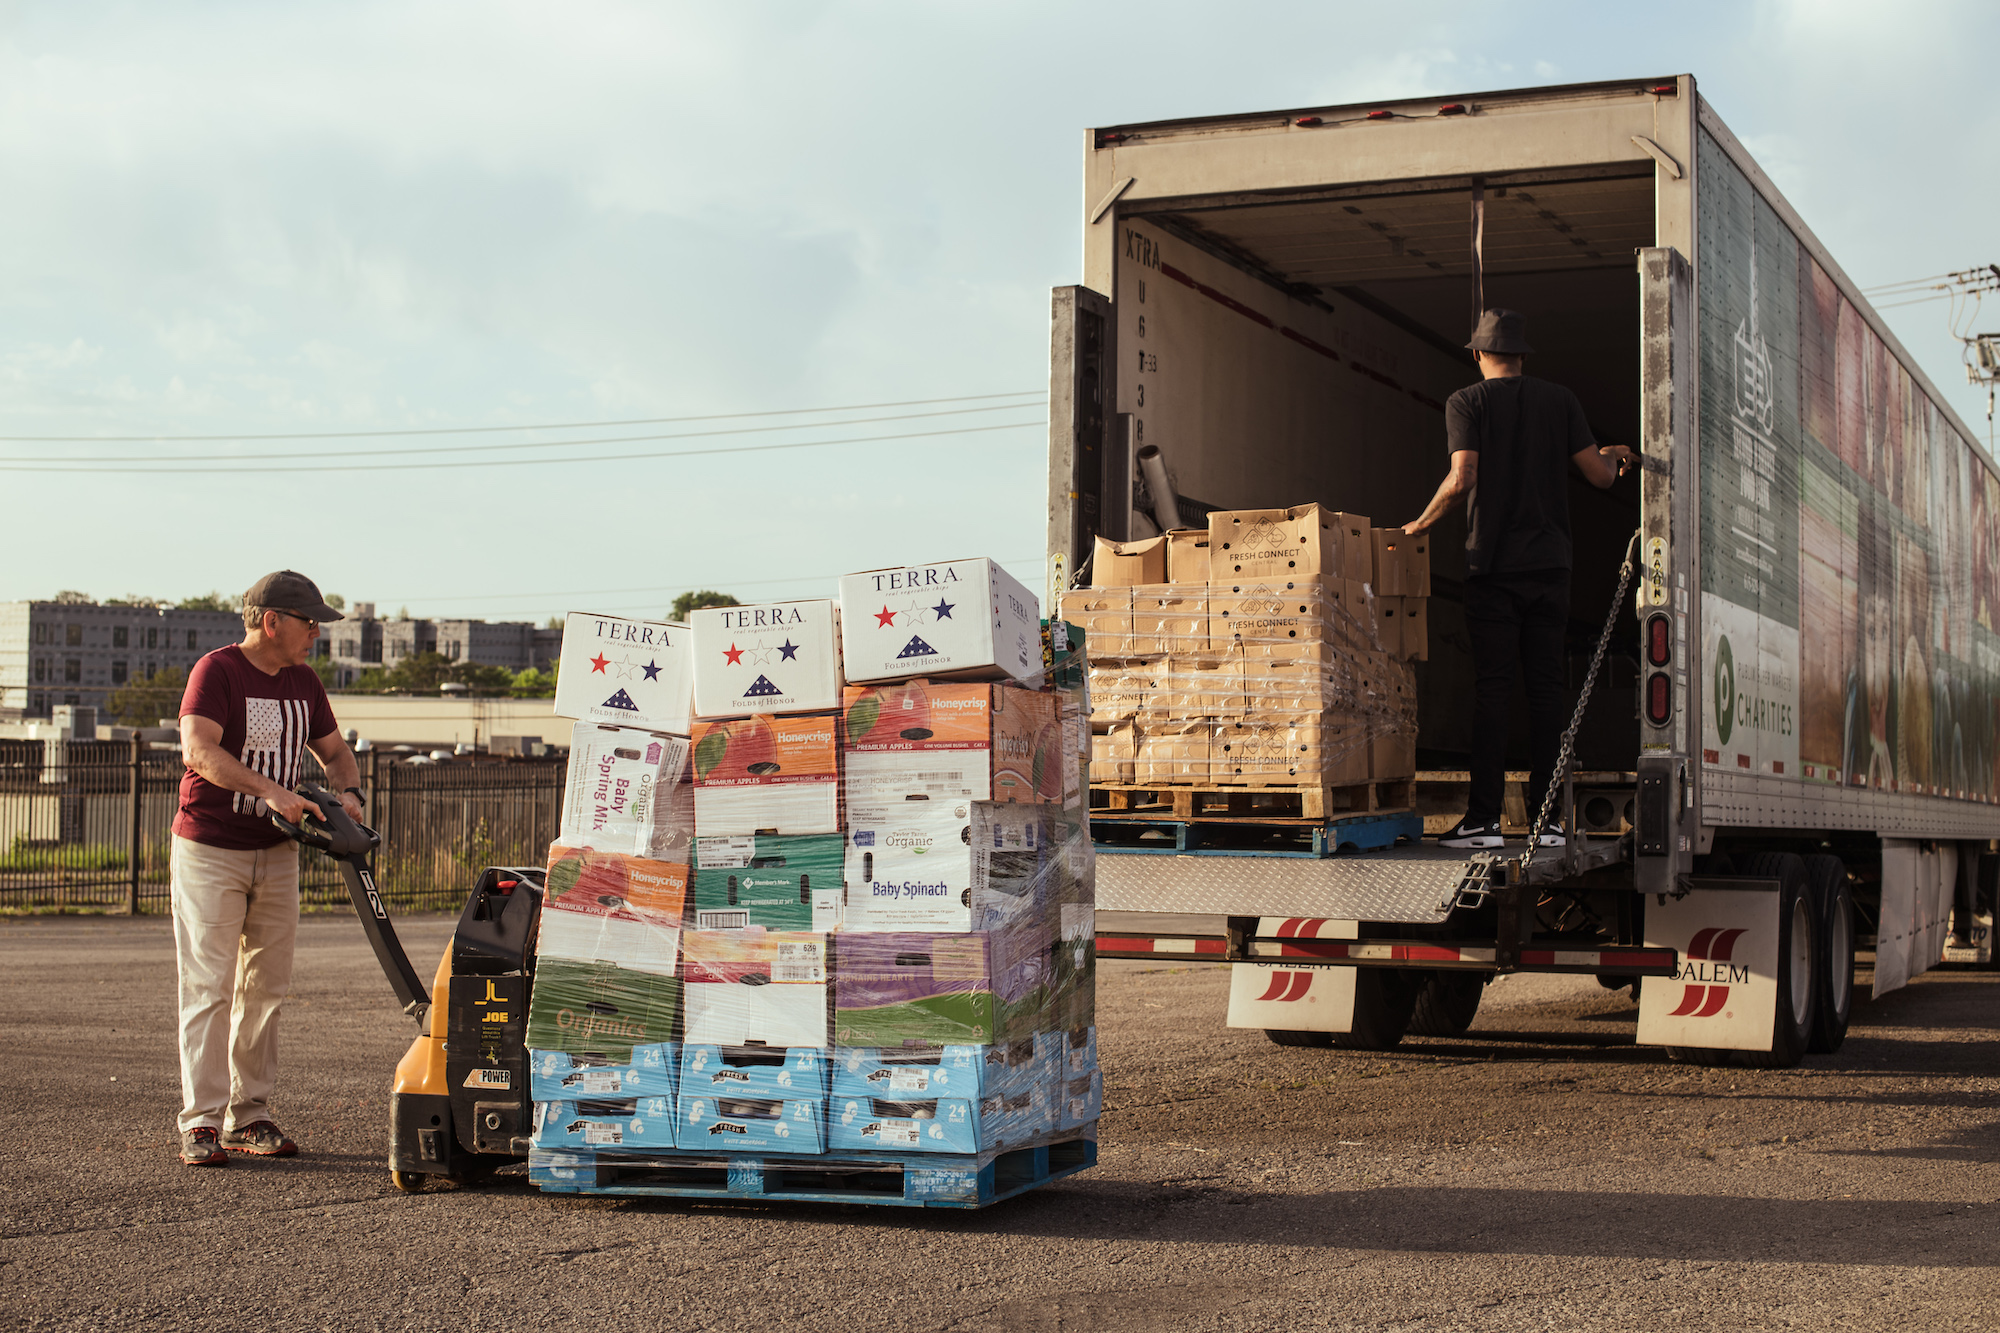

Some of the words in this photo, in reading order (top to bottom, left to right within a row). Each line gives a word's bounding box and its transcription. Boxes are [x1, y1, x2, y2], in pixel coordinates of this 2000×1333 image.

[1126, 228, 1160, 271] XTRA
[1229, 552, 1256, 561] FRESH
[1258, 549, 1301, 559] CONNECT
[871, 567, 959, 591] TERRA
[900, 588, 930, 596] vegetable
[1008, 594, 1029, 622] TERRA
[721, 607, 803, 629] TERRA
[1228, 620, 1255, 629] FRESH
[1256, 618, 1299, 628] CONNECT
[594, 620, 671, 647] TERRA
[747, 626, 776, 634] vegetable
[617, 641, 644, 650] vegetable
[645, 644, 661, 653] chips
[884, 662, 911, 670] FOLDS
[912, 660, 918, 668] of
[920, 656, 952, 666] HONOR
[732, 700, 757, 708] FOLDS
[758, 699, 764, 707] of
[766, 697, 795, 706] HONOR
[931, 696, 987, 710] Honeycrisp
[1090, 695, 1108, 703] RESH
[1110, 692, 1150, 701] CONNECT
[589, 706, 613, 717] FOLDS
[614, 710, 621, 718] of
[1738, 692, 1792, 737] CHARITIES
[777, 730, 832, 744] Honeycrisp
[1229, 757, 1256, 765] FRESH
[1258, 756, 1300, 765] CONNECT
[594, 754, 616, 802] Spring
[704, 778, 735, 786] PREMIUM
[610, 778, 630, 814] Baby
[637, 773, 652, 823] Organic
[593, 804, 609, 831] Mix
[885, 836, 933, 849] Organic
[630, 870, 684, 889] Honeycrisp
[873, 881, 901, 900] Baby
[903, 881, 948, 900] Spinach
[554, 901, 585, 912] PREMIUM
[585, 906, 608, 915] APPLES
[838, 973, 878, 982] ROMAINE
[880, 973, 915, 981] HEARTS
[1669, 961, 1749, 984] SALEM
[482, 1012, 509, 1023] JOE
[556, 1008, 647, 1039] Organics
[643, 1049, 660, 1062] 24
[796, 1052, 815, 1065] 24
[953, 1050, 971, 1062] 24
[482, 1070, 510, 1083] POWER
[722, 1071, 744, 1080] FRESH
[647, 1099, 664, 1112] 24
[793, 1104, 811, 1117] 24
[948, 1104, 967, 1118] 24
[719, 1124, 742, 1133] FRESH
